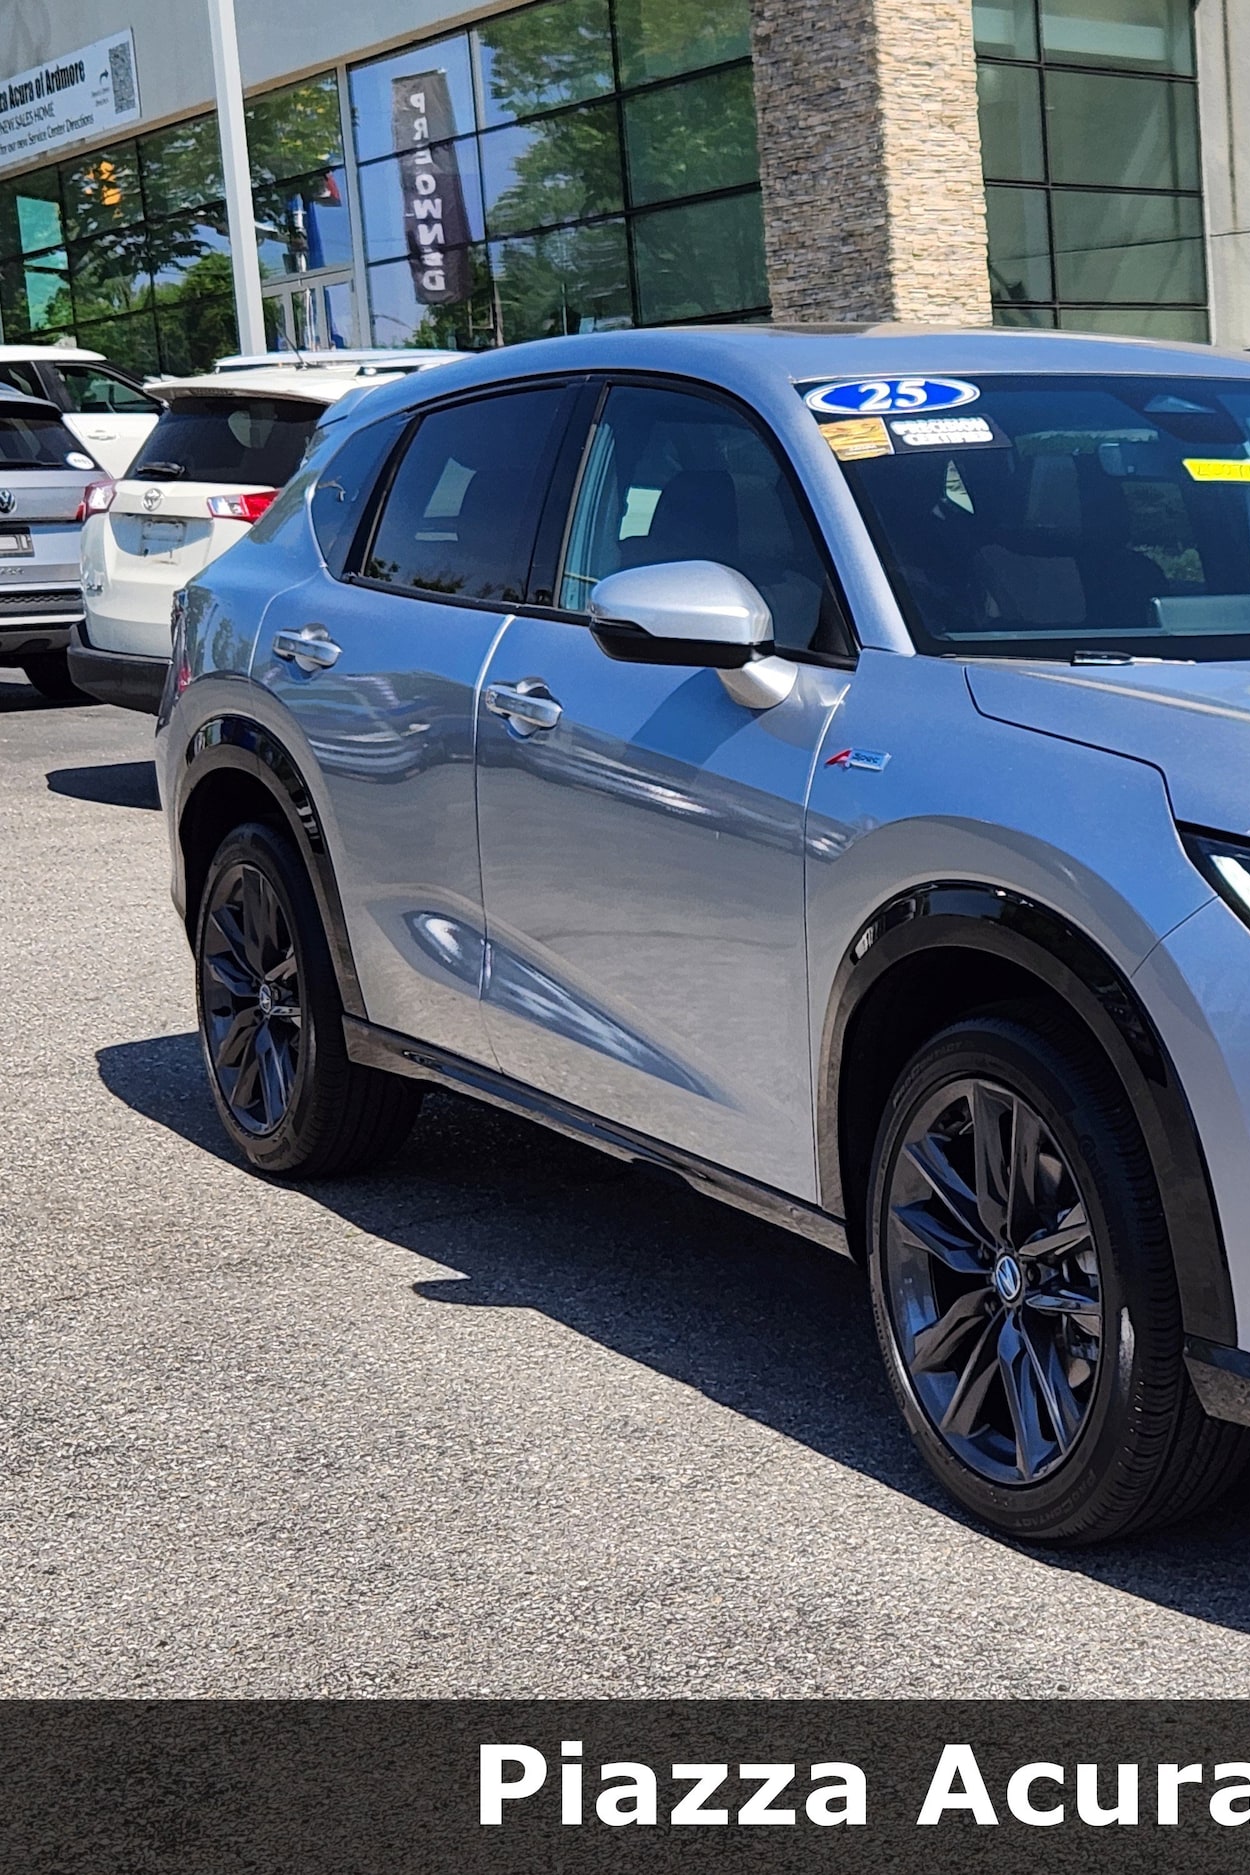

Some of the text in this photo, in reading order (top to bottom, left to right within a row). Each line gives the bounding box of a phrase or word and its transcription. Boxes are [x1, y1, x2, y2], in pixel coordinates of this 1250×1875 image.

[8, 82, 34, 110] Acura
[35, 71, 46, 99] of
[45, 60, 86, 96] Ardmore
[15, 110, 34, 130] SALES
[33, 102, 55, 122] HOME
[28, 131, 48, 146] Service
[46, 124, 66, 139] Center
[66, 114, 94, 133] Directions
[858, 379, 928, 412] 25
